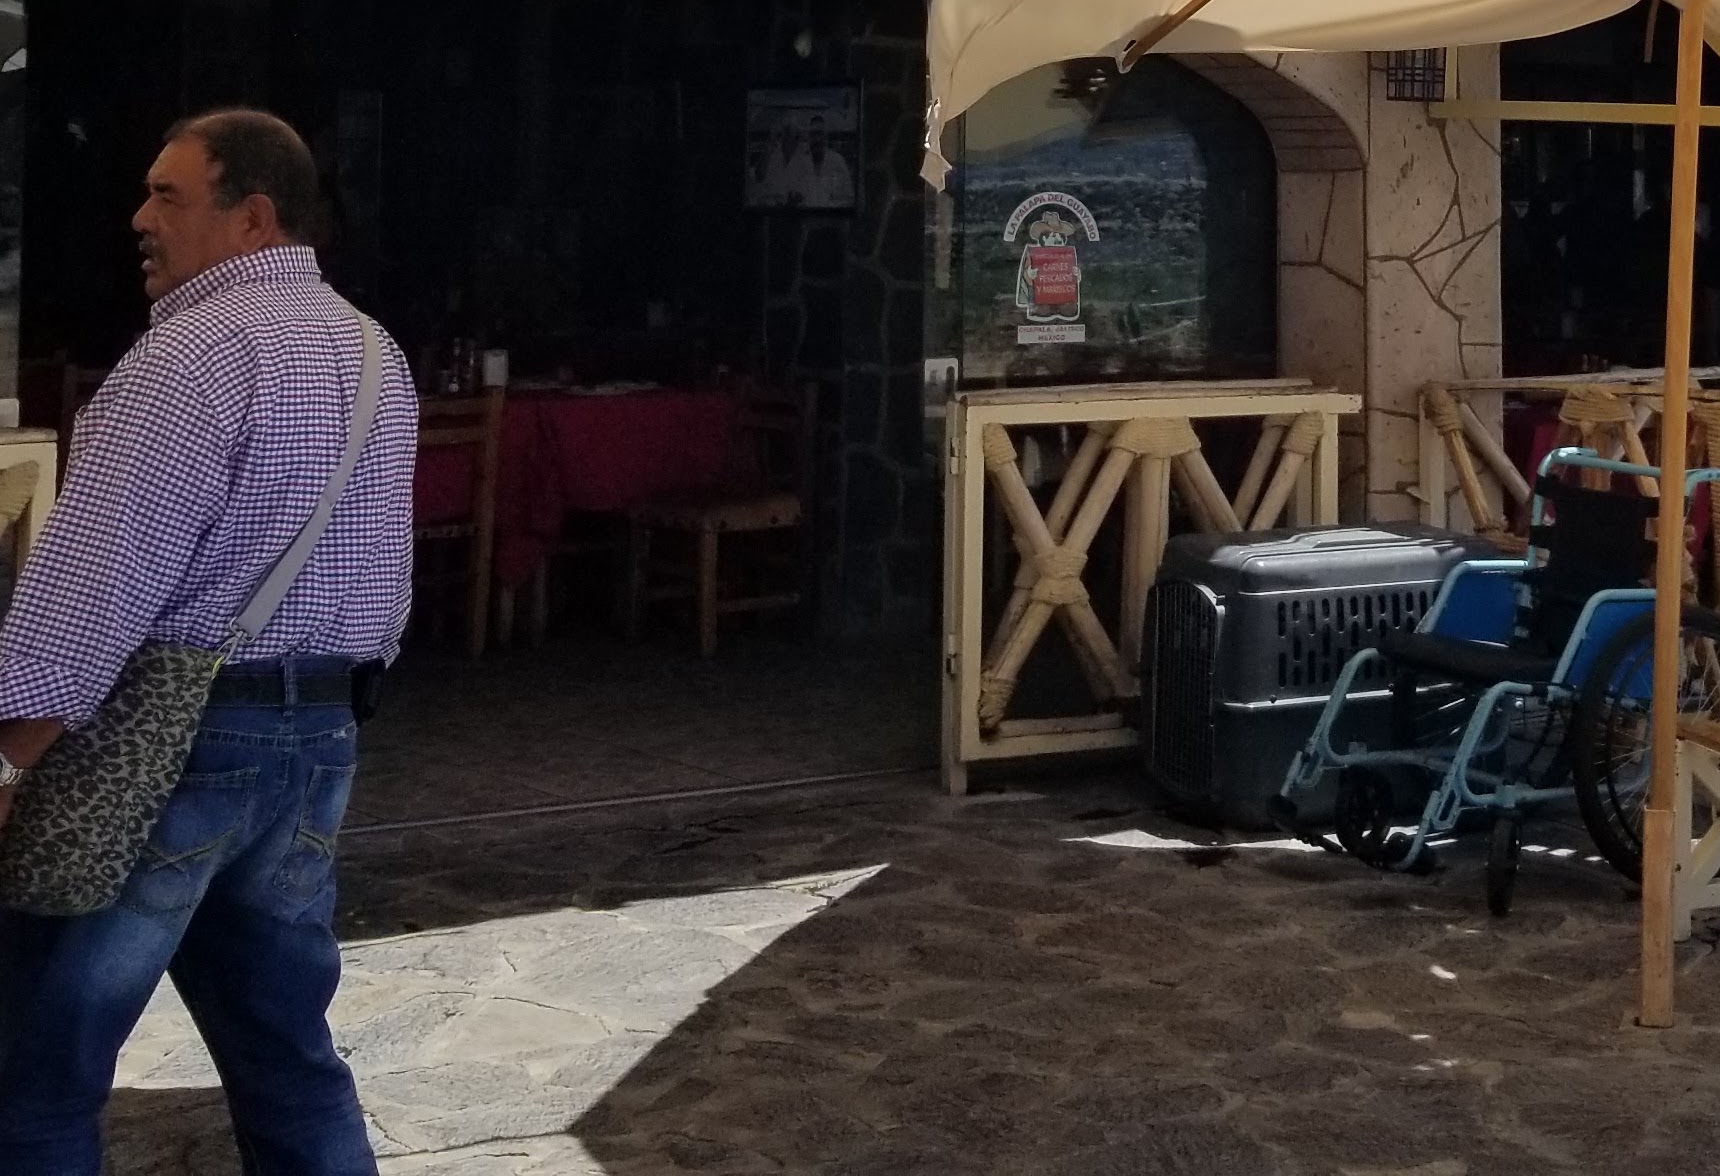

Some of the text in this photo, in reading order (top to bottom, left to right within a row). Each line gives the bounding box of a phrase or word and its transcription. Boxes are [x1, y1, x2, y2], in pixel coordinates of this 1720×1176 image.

[1007, 193, 1097, 240] LA PALAPA DEL GUAYABO
